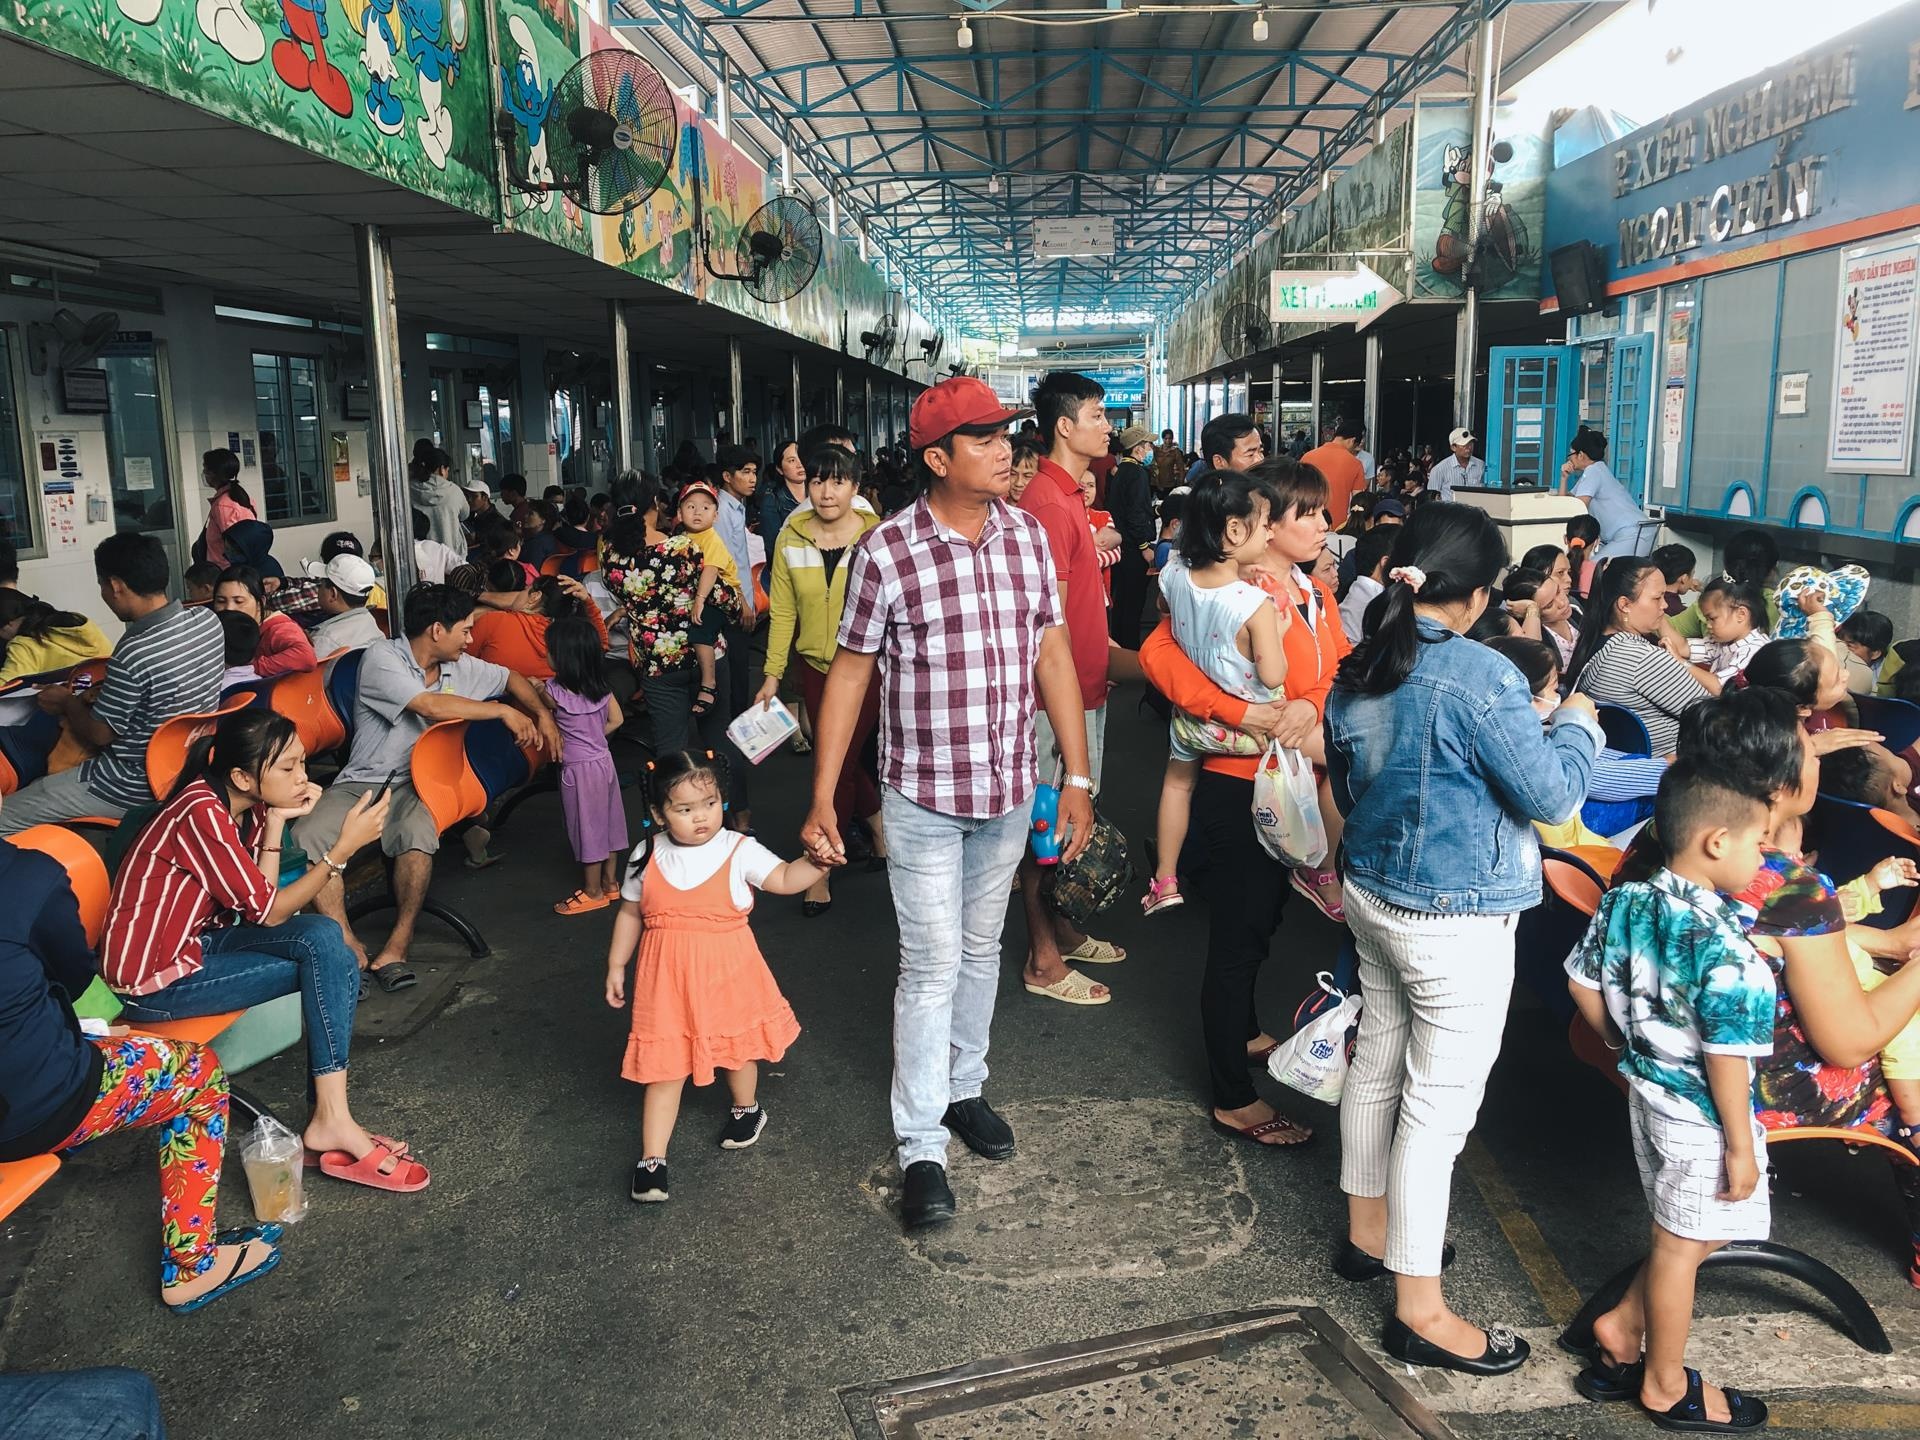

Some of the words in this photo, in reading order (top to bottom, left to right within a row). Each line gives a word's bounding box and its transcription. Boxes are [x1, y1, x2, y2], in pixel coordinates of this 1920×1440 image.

[1632, 114, 1697, 190] XÉT
[1617, 195, 1709, 267] NGOẠI
[1111, 390, 1129, 402] TIẾP
